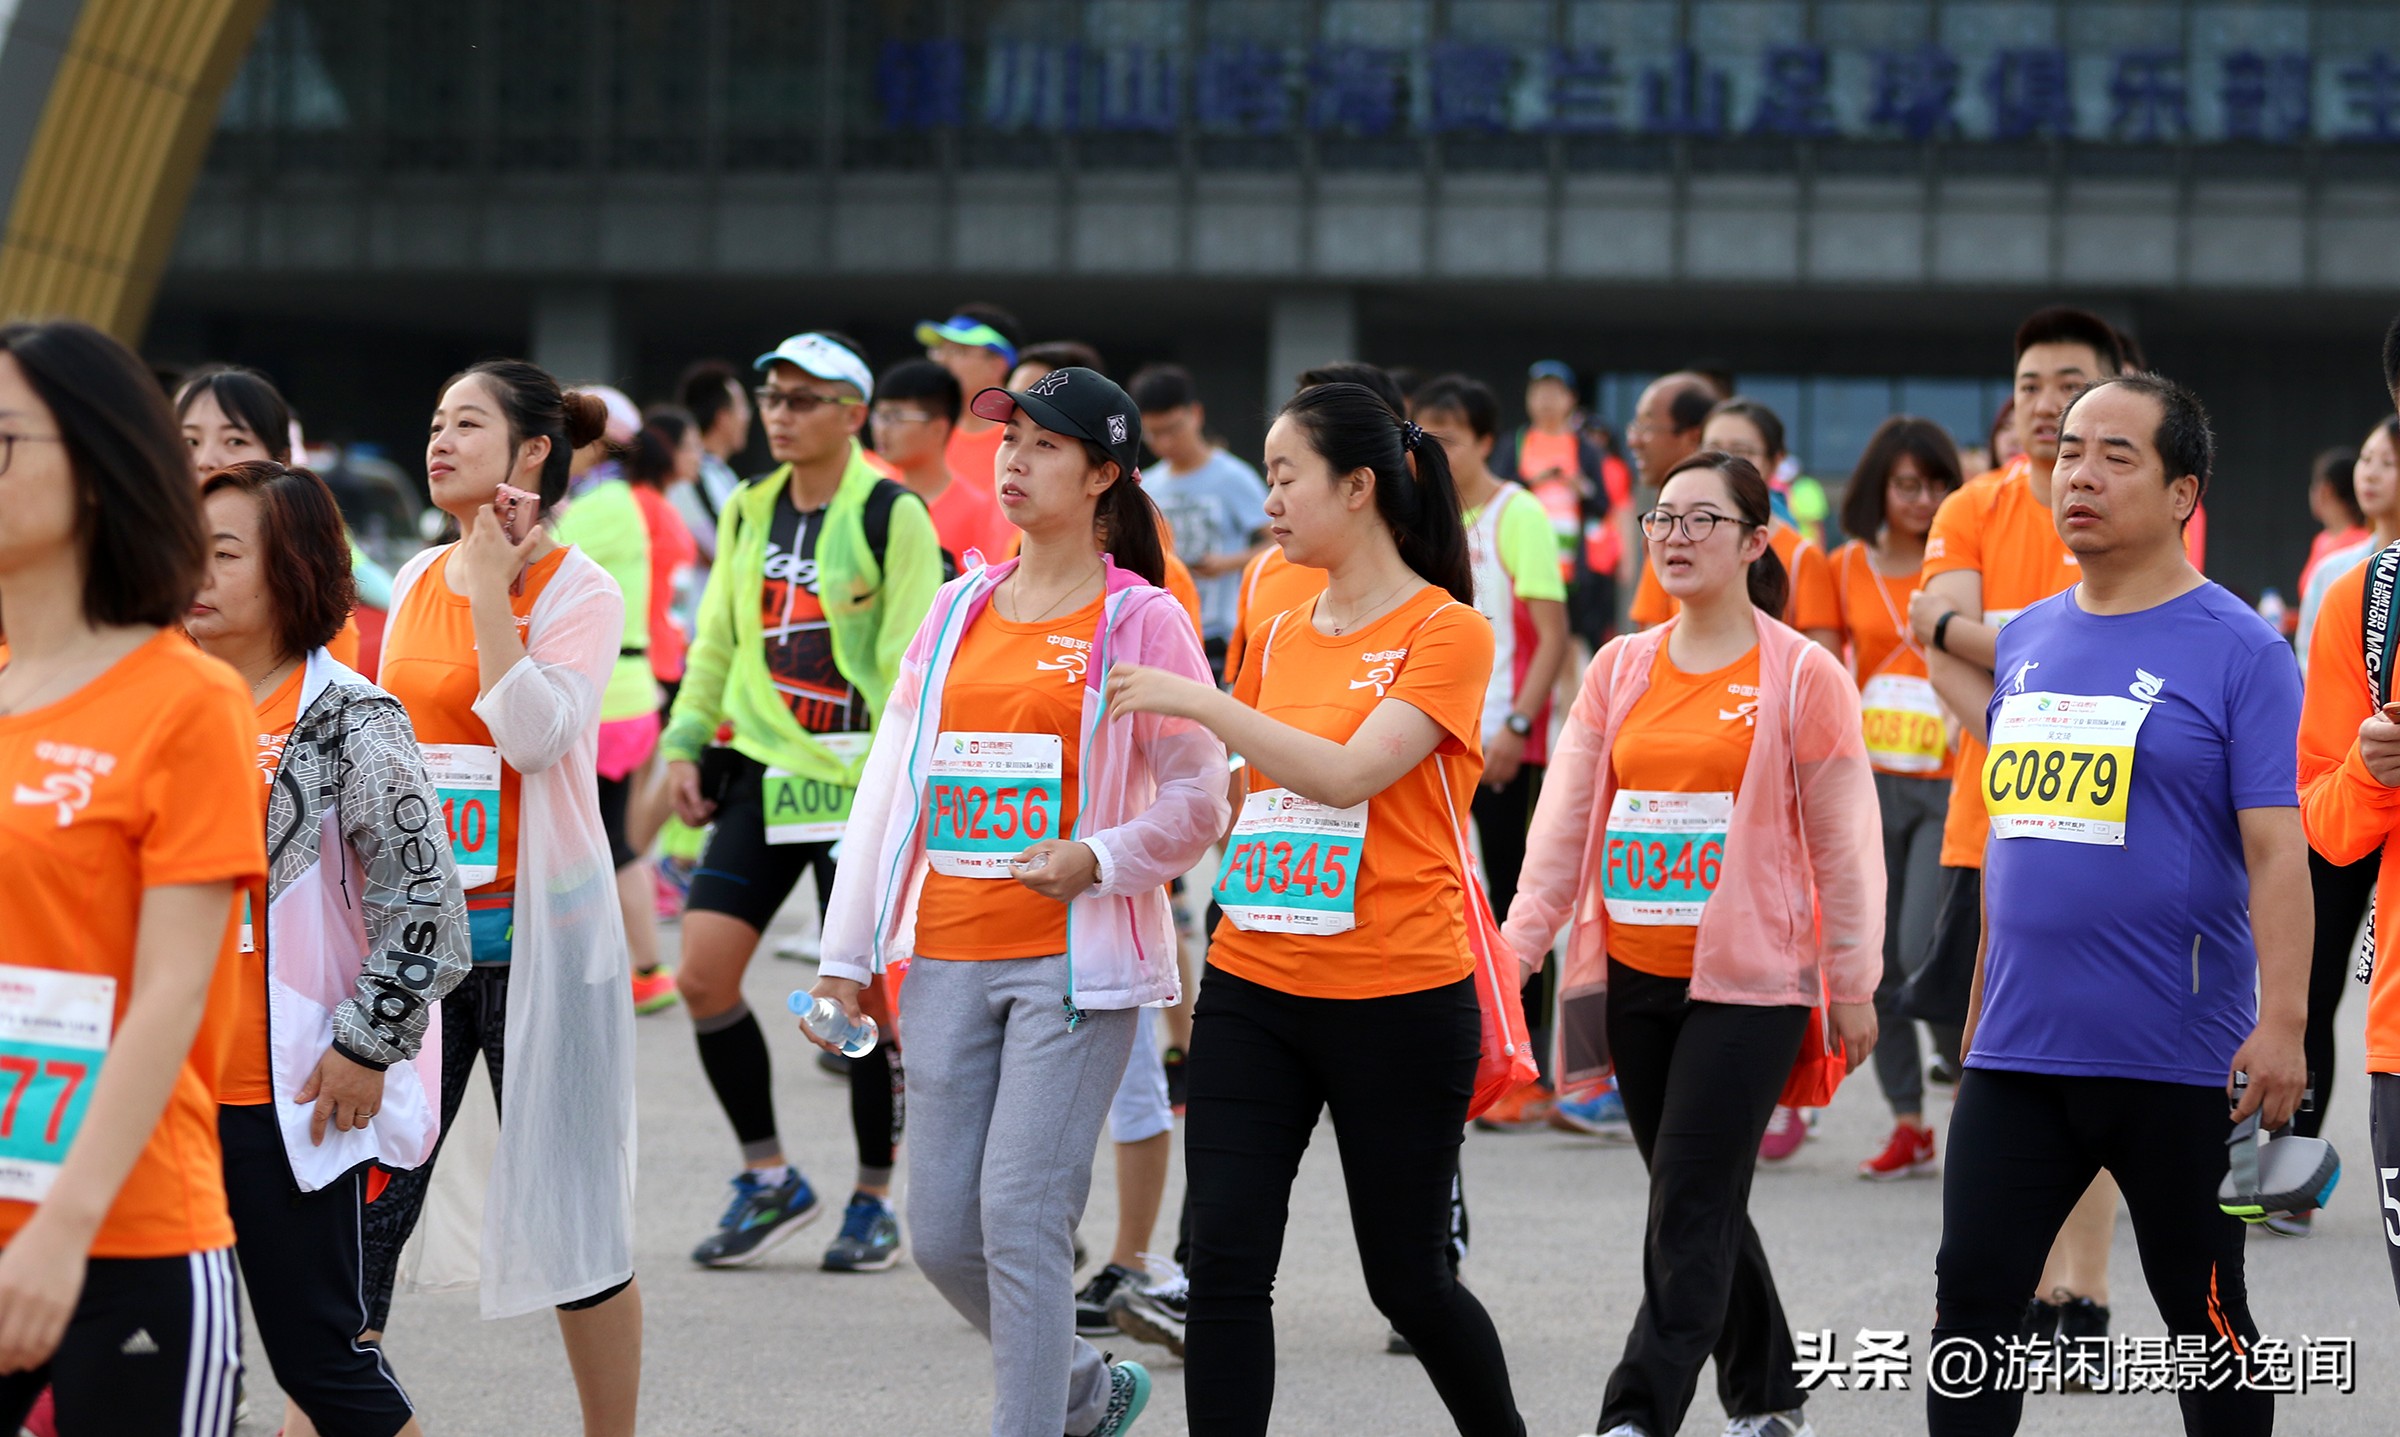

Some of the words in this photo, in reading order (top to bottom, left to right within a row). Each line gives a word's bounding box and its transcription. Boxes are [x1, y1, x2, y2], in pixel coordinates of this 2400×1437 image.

[2368, 580, 2382, 628] EDITION
[2377, 582, 2392, 631] LIMITED
[1361, 648, 1408, 663] 中国平安
[773, 781, 857, 816] A00
[1989, 750, 2117, 806] C0879
[933, 785, 1049, 840] F0256
[393, 794, 442, 907] neo
[1219, 841, 1349, 898] F0345
[1607, 839, 1722, 891] F0346
